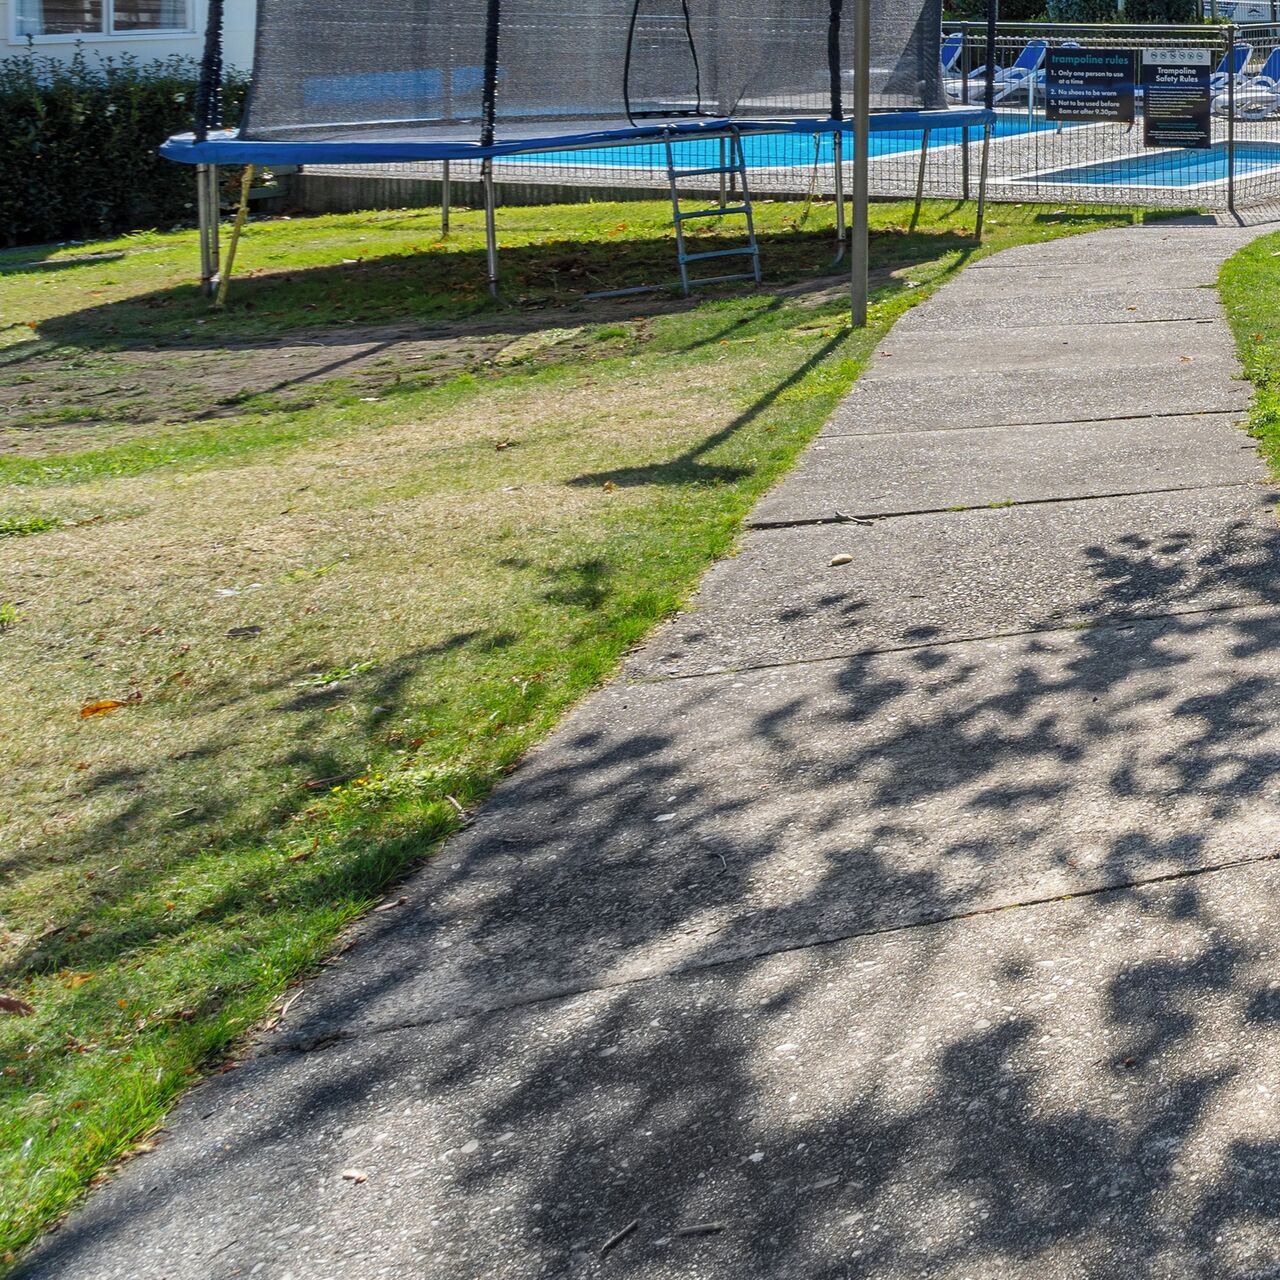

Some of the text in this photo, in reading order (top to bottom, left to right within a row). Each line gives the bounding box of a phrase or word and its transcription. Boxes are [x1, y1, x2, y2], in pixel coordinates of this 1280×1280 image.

[1052, 54, 1129, 66] trampoline rules
[1157, 67, 1196, 75] Trampoline
[1156, 75, 1178, 83] Safety
